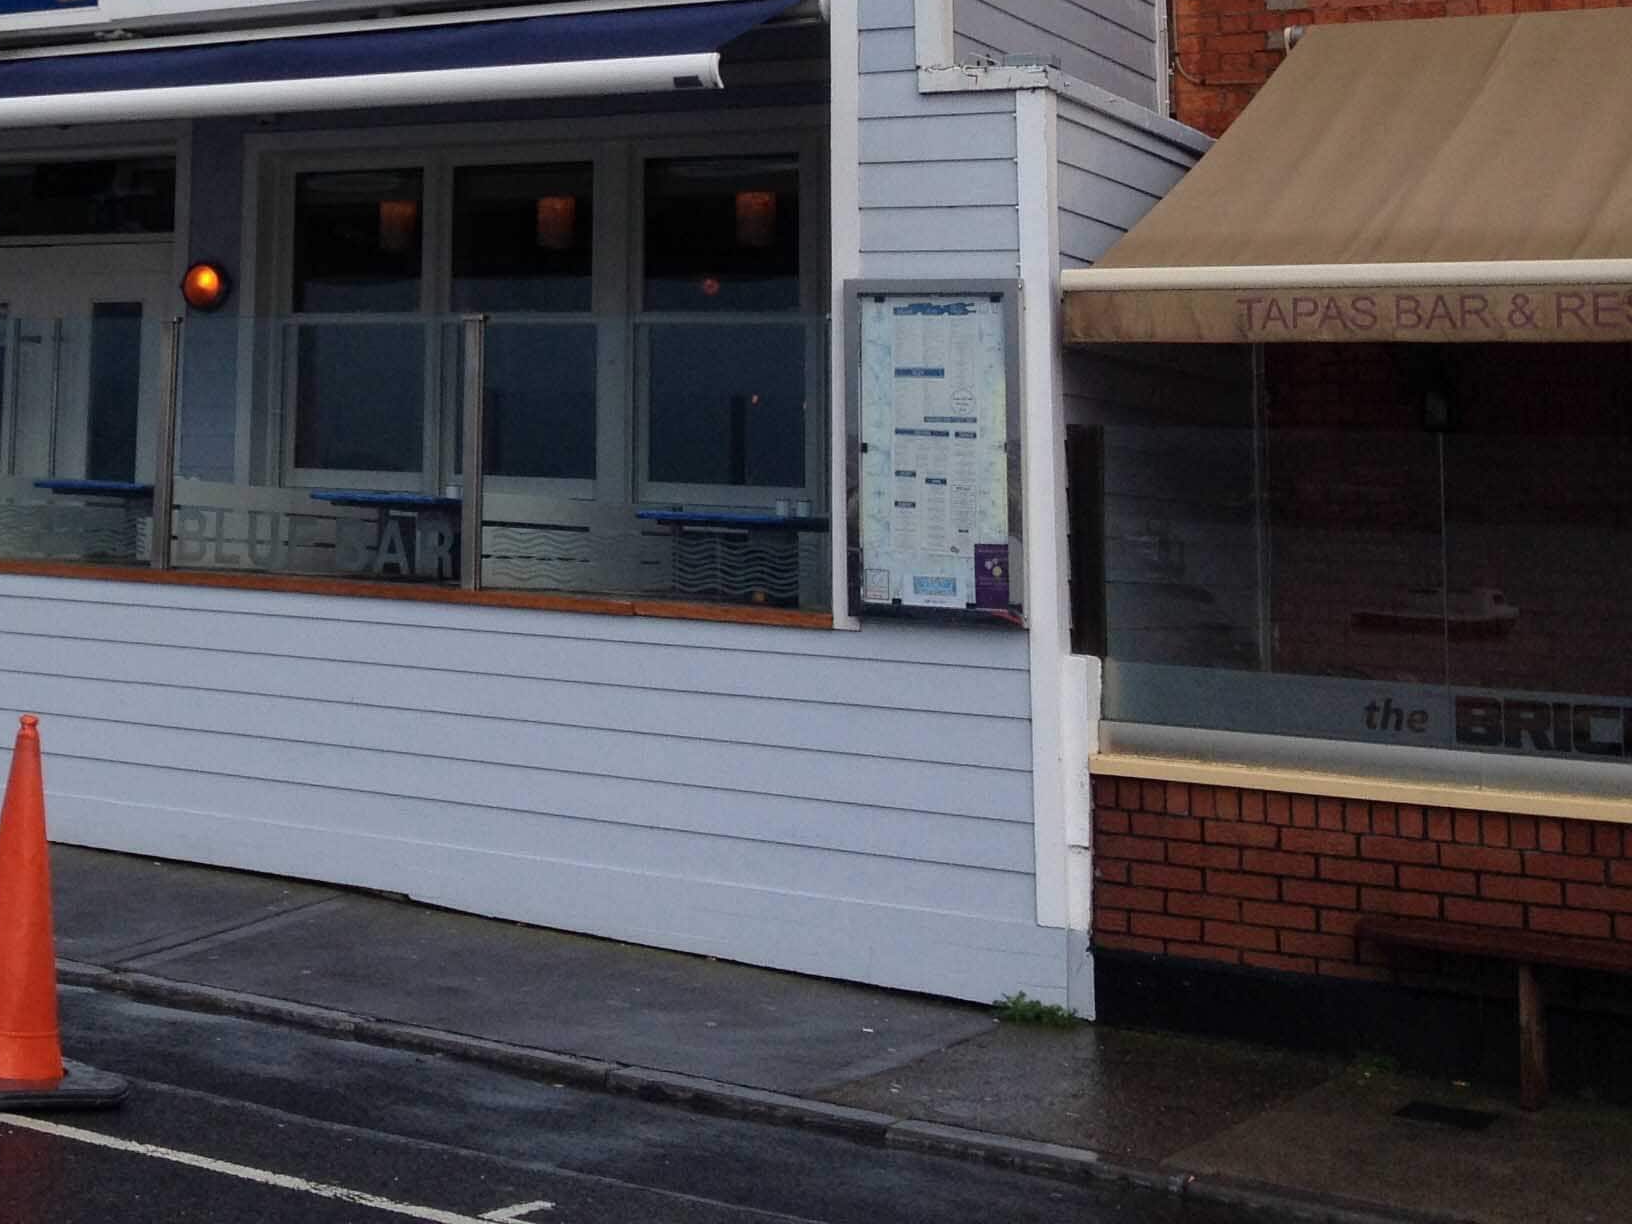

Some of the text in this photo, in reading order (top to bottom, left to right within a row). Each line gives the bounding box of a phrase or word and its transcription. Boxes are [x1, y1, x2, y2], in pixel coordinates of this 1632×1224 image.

[1236, 294, 1377, 332] TAPAS
[1394, 293, 1493, 330] BAR
[1507, 293, 1538, 329] &
[1363, 695, 1632, 756] the BRIC
